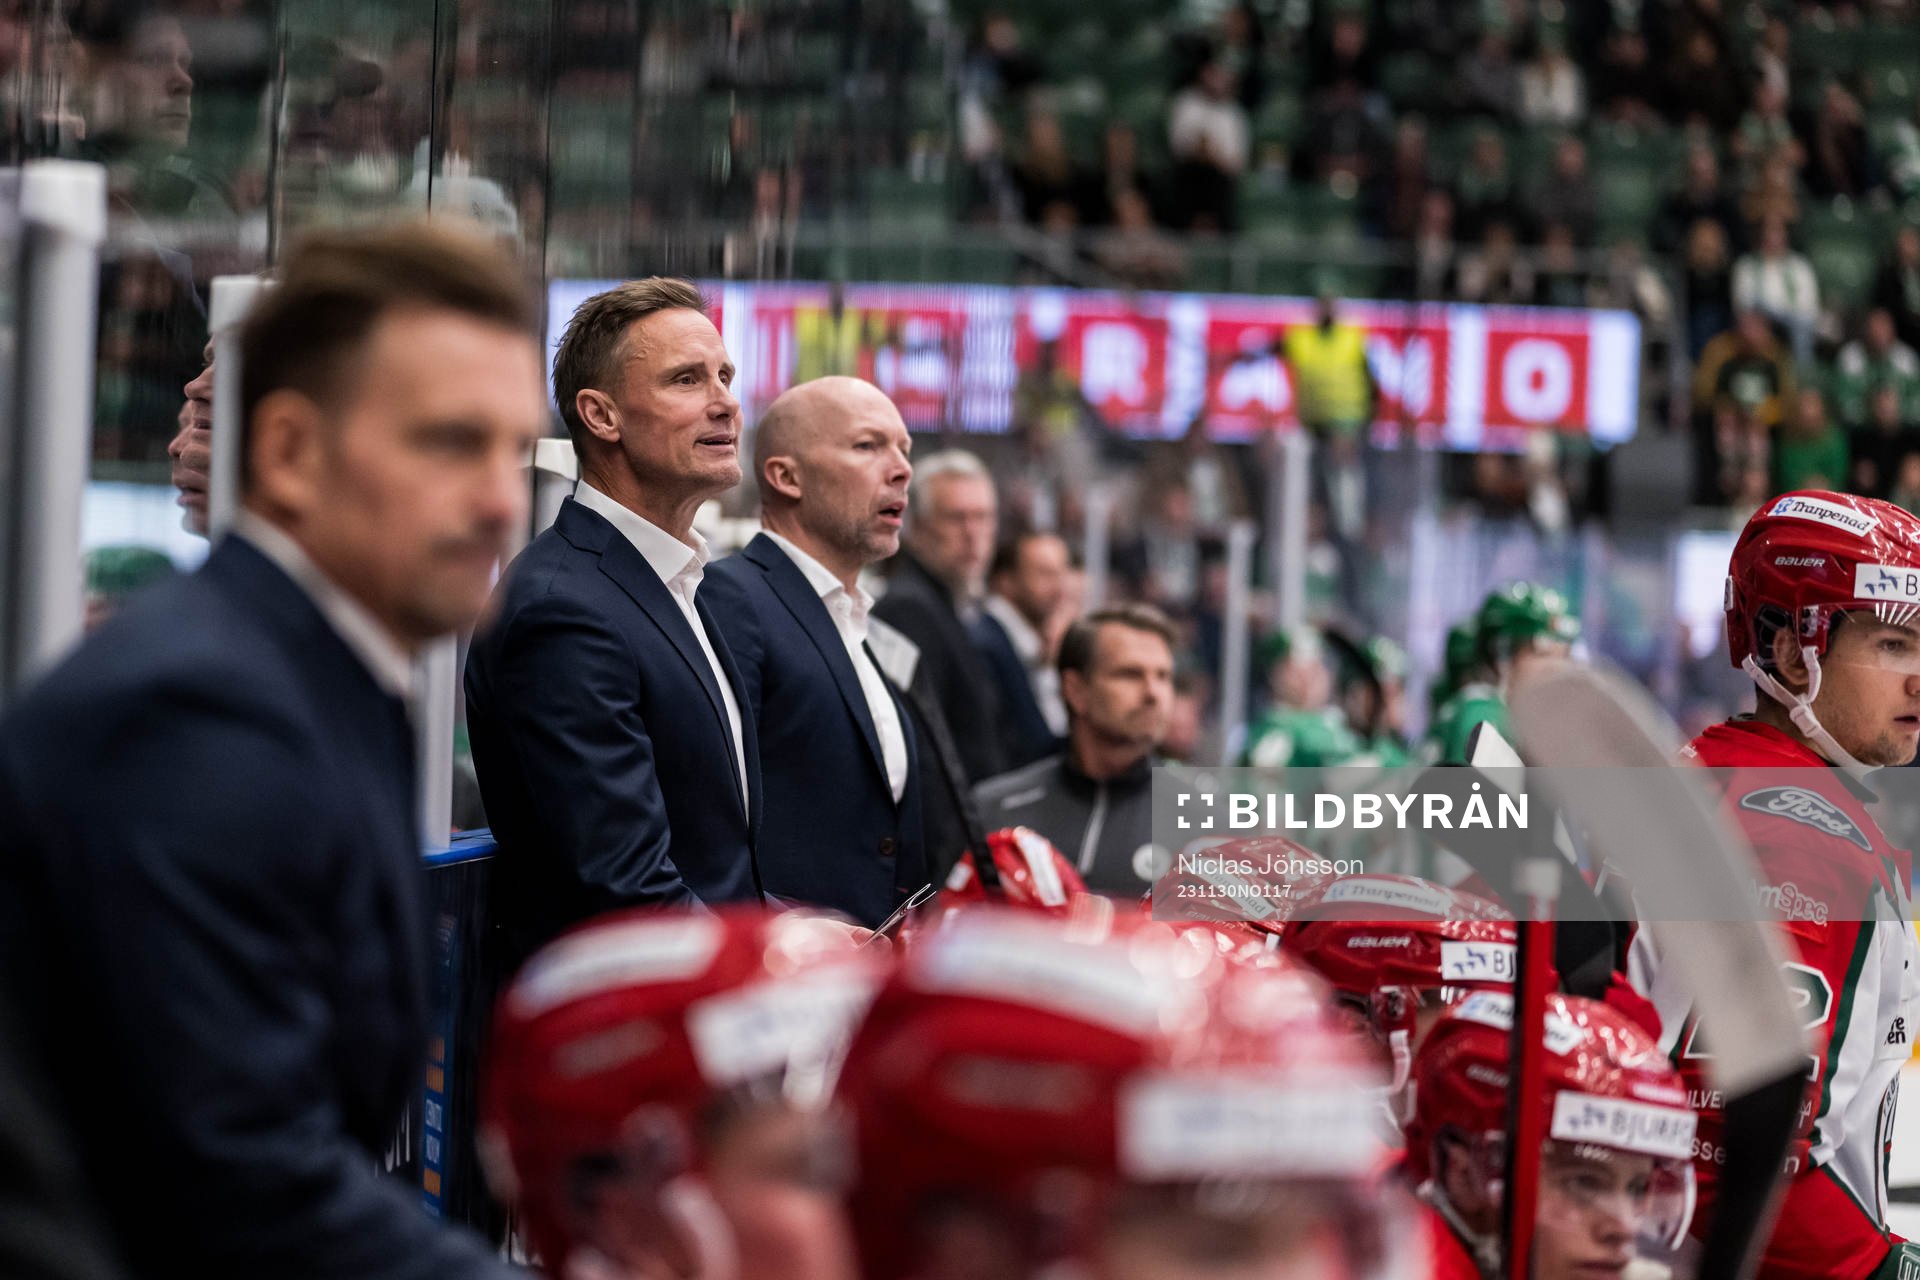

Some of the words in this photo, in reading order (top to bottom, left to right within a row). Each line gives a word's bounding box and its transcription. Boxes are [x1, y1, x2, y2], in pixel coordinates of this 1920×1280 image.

[1792, 500, 1871, 531] Tranpenad
[1774, 556, 1826, 568] BAUER
[1768, 789, 1854, 835] Ford
[1687, 1089, 1727, 1109] ILVE
